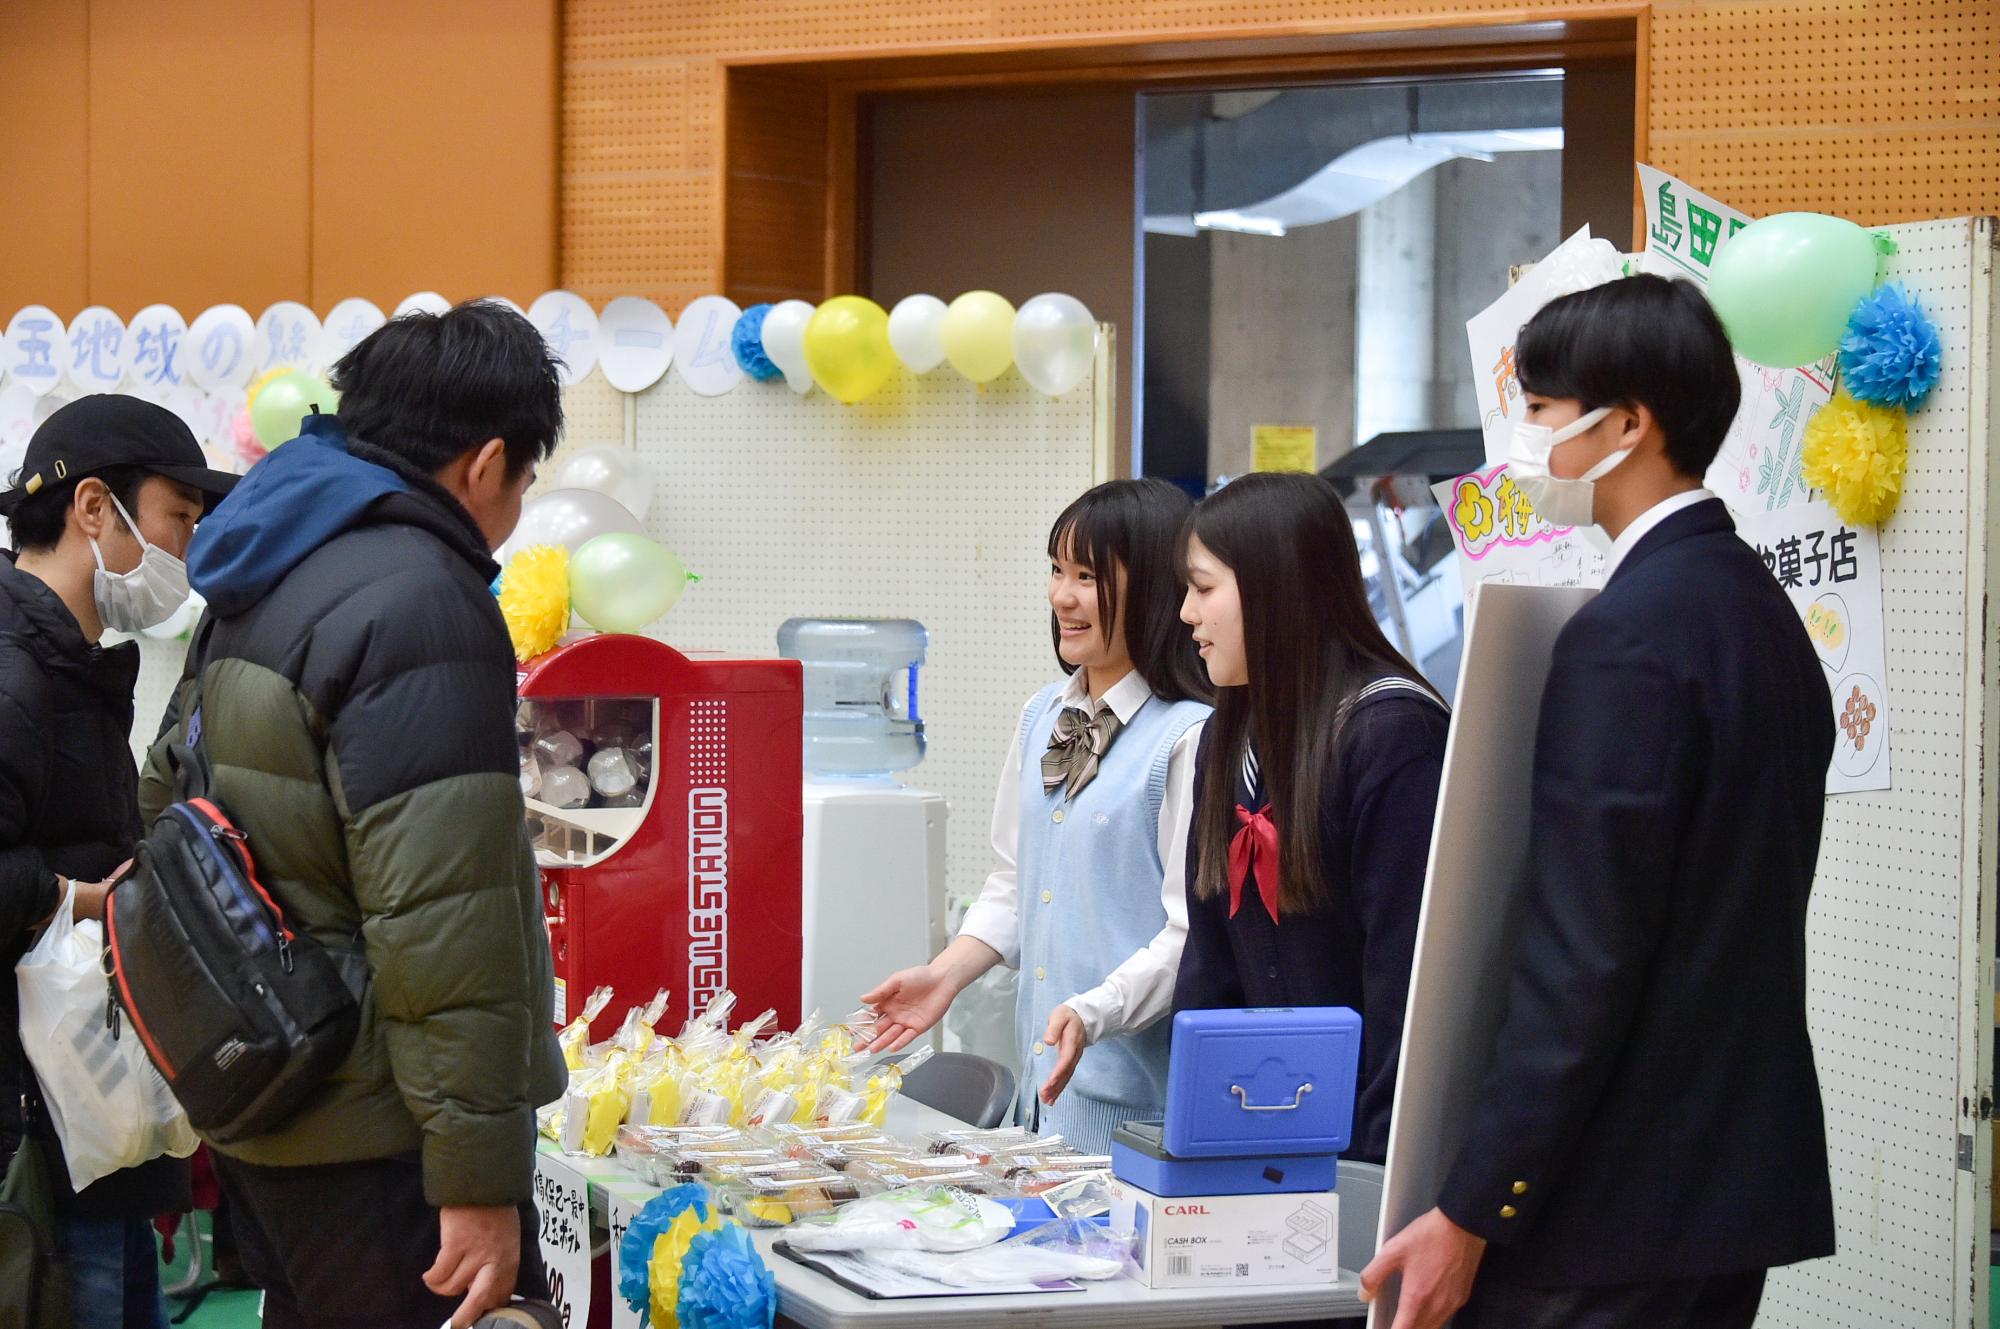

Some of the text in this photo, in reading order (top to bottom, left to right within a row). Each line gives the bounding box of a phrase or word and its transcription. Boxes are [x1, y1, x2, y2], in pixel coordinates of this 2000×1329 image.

[1651, 180, 1748, 268] 島田
[688, 787, 728, 912] STATION
[1164, 1204, 1211, 1216] CARL
[1167, 1237, 1189, 1245] CASH
[1190, 1236, 1208, 1245] BOX
